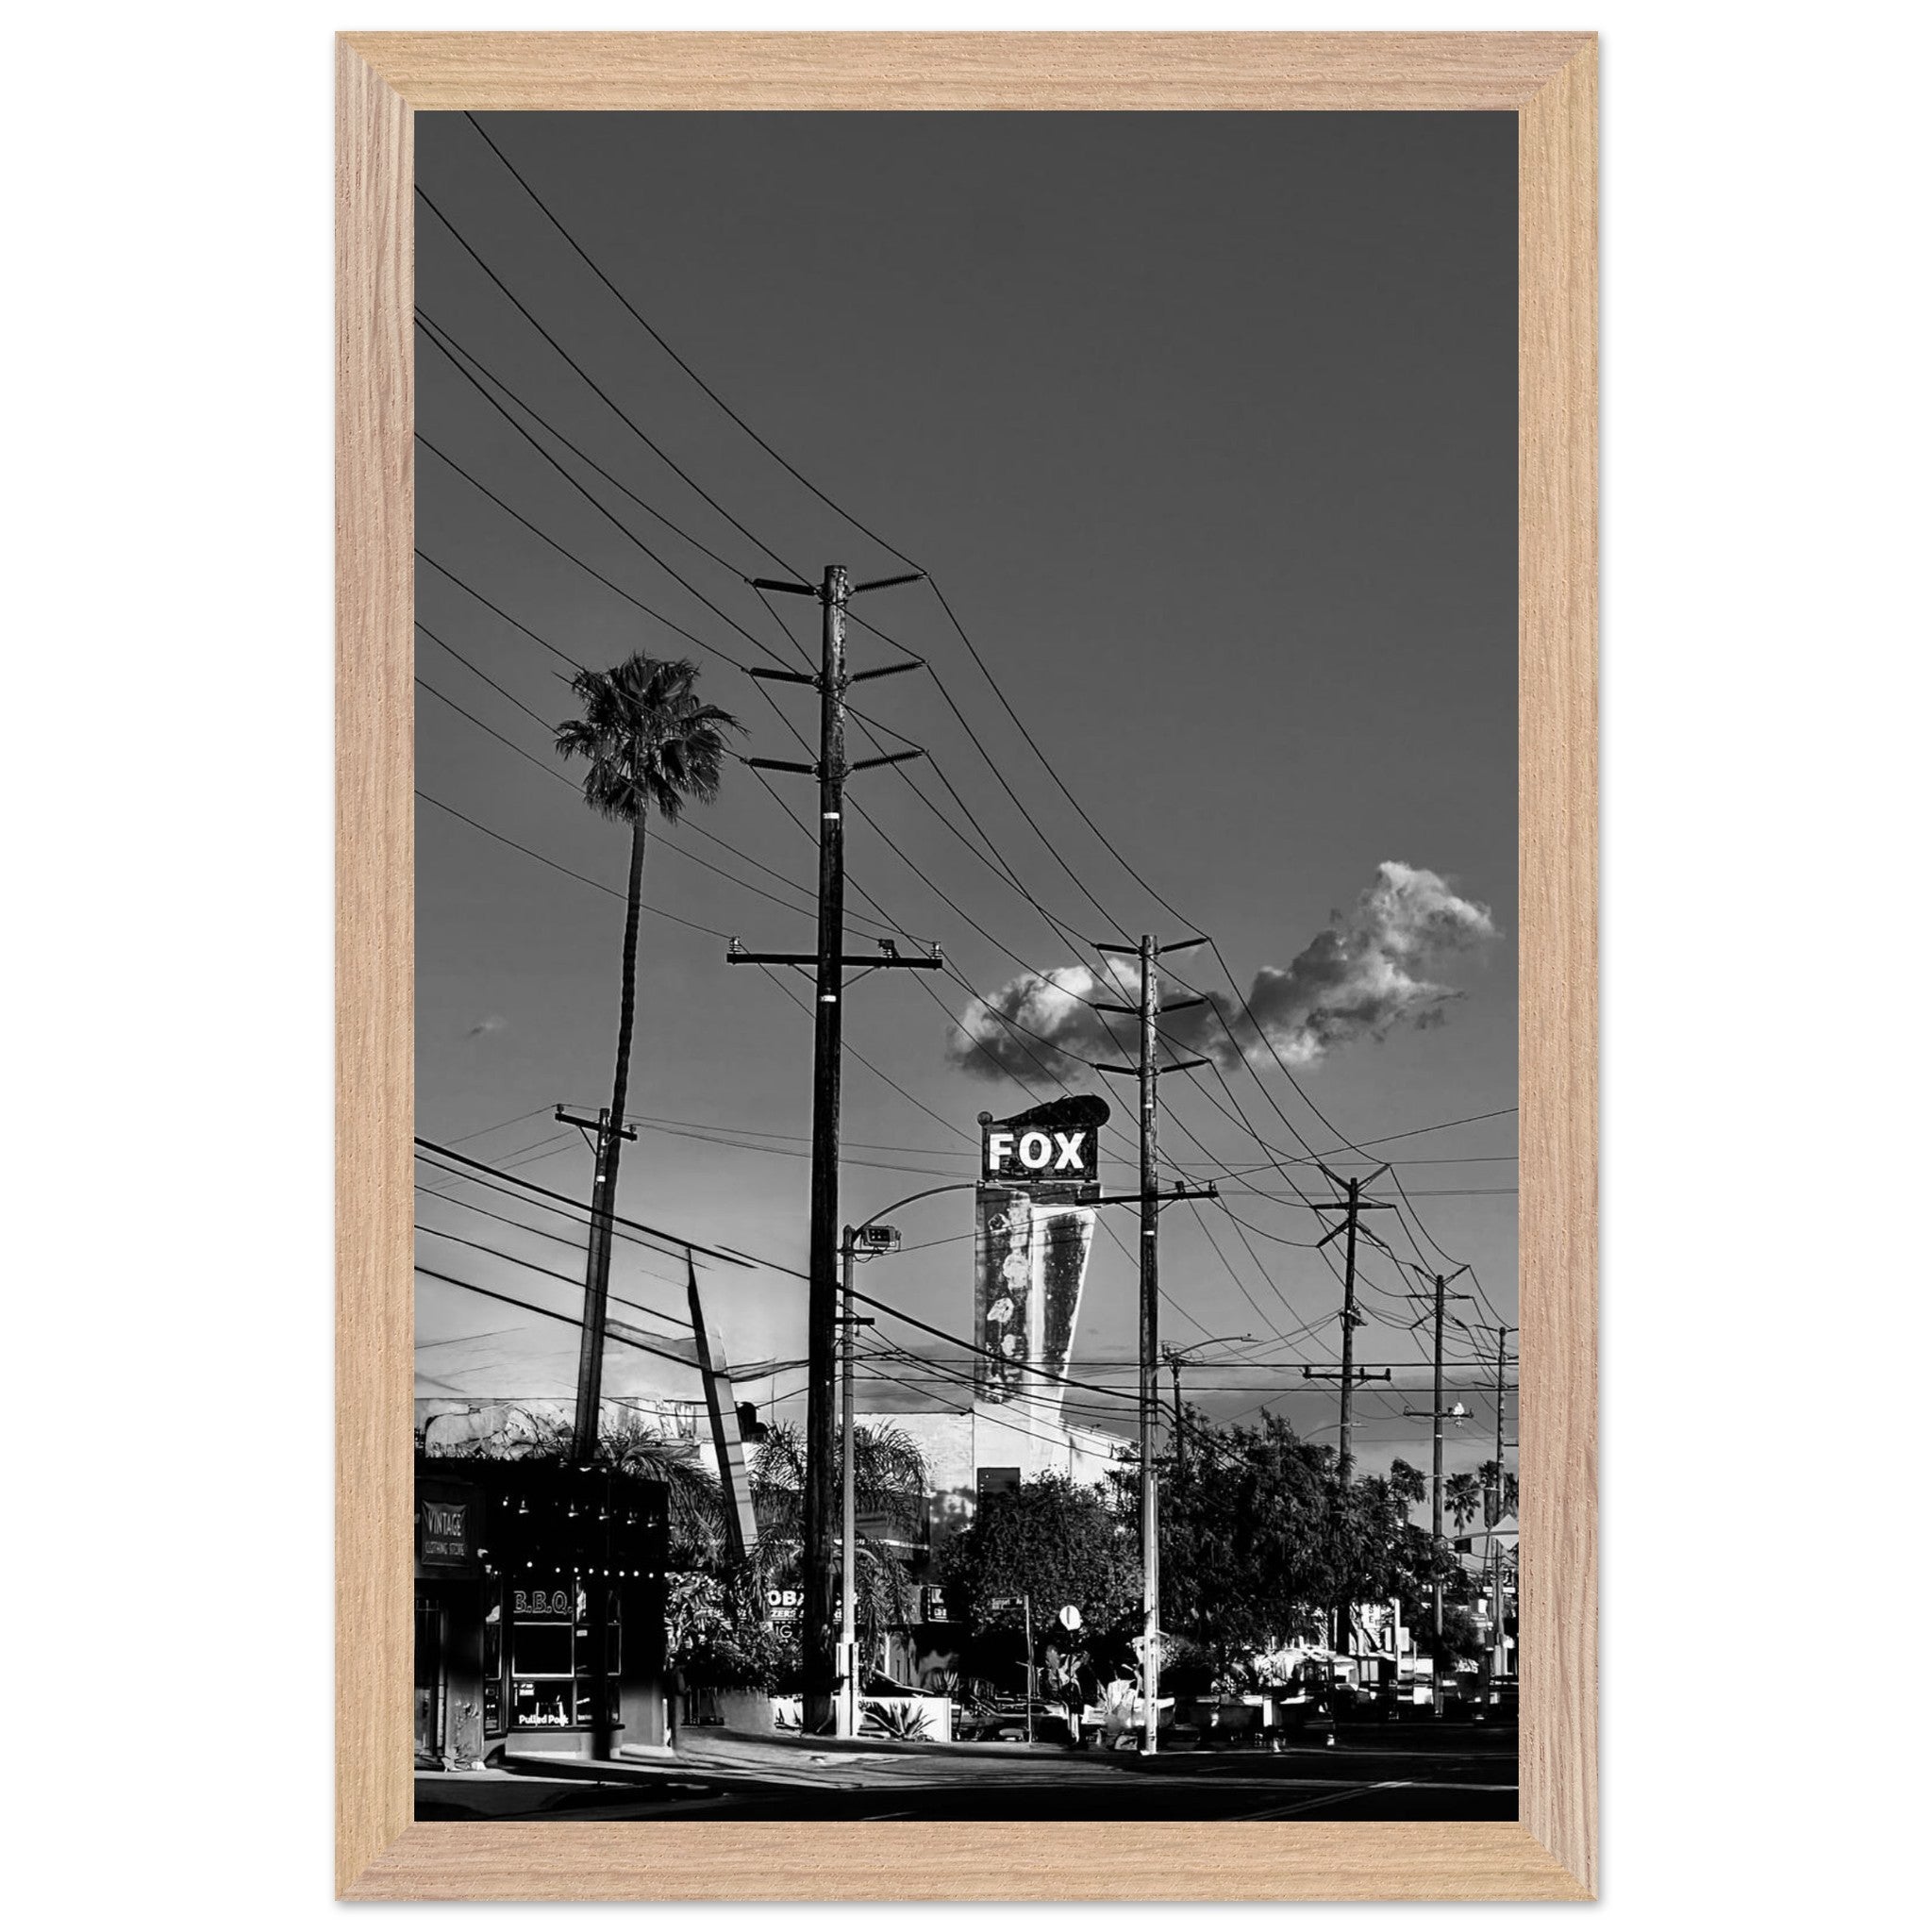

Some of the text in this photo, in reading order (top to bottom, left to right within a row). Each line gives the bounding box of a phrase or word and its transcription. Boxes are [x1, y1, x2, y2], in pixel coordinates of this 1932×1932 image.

[990, 1131, 1087, 1171] FOX
[427, 1510, 462, 1537] VINTAGE
[513, 1591, 574, 1615] B.B.Q.
